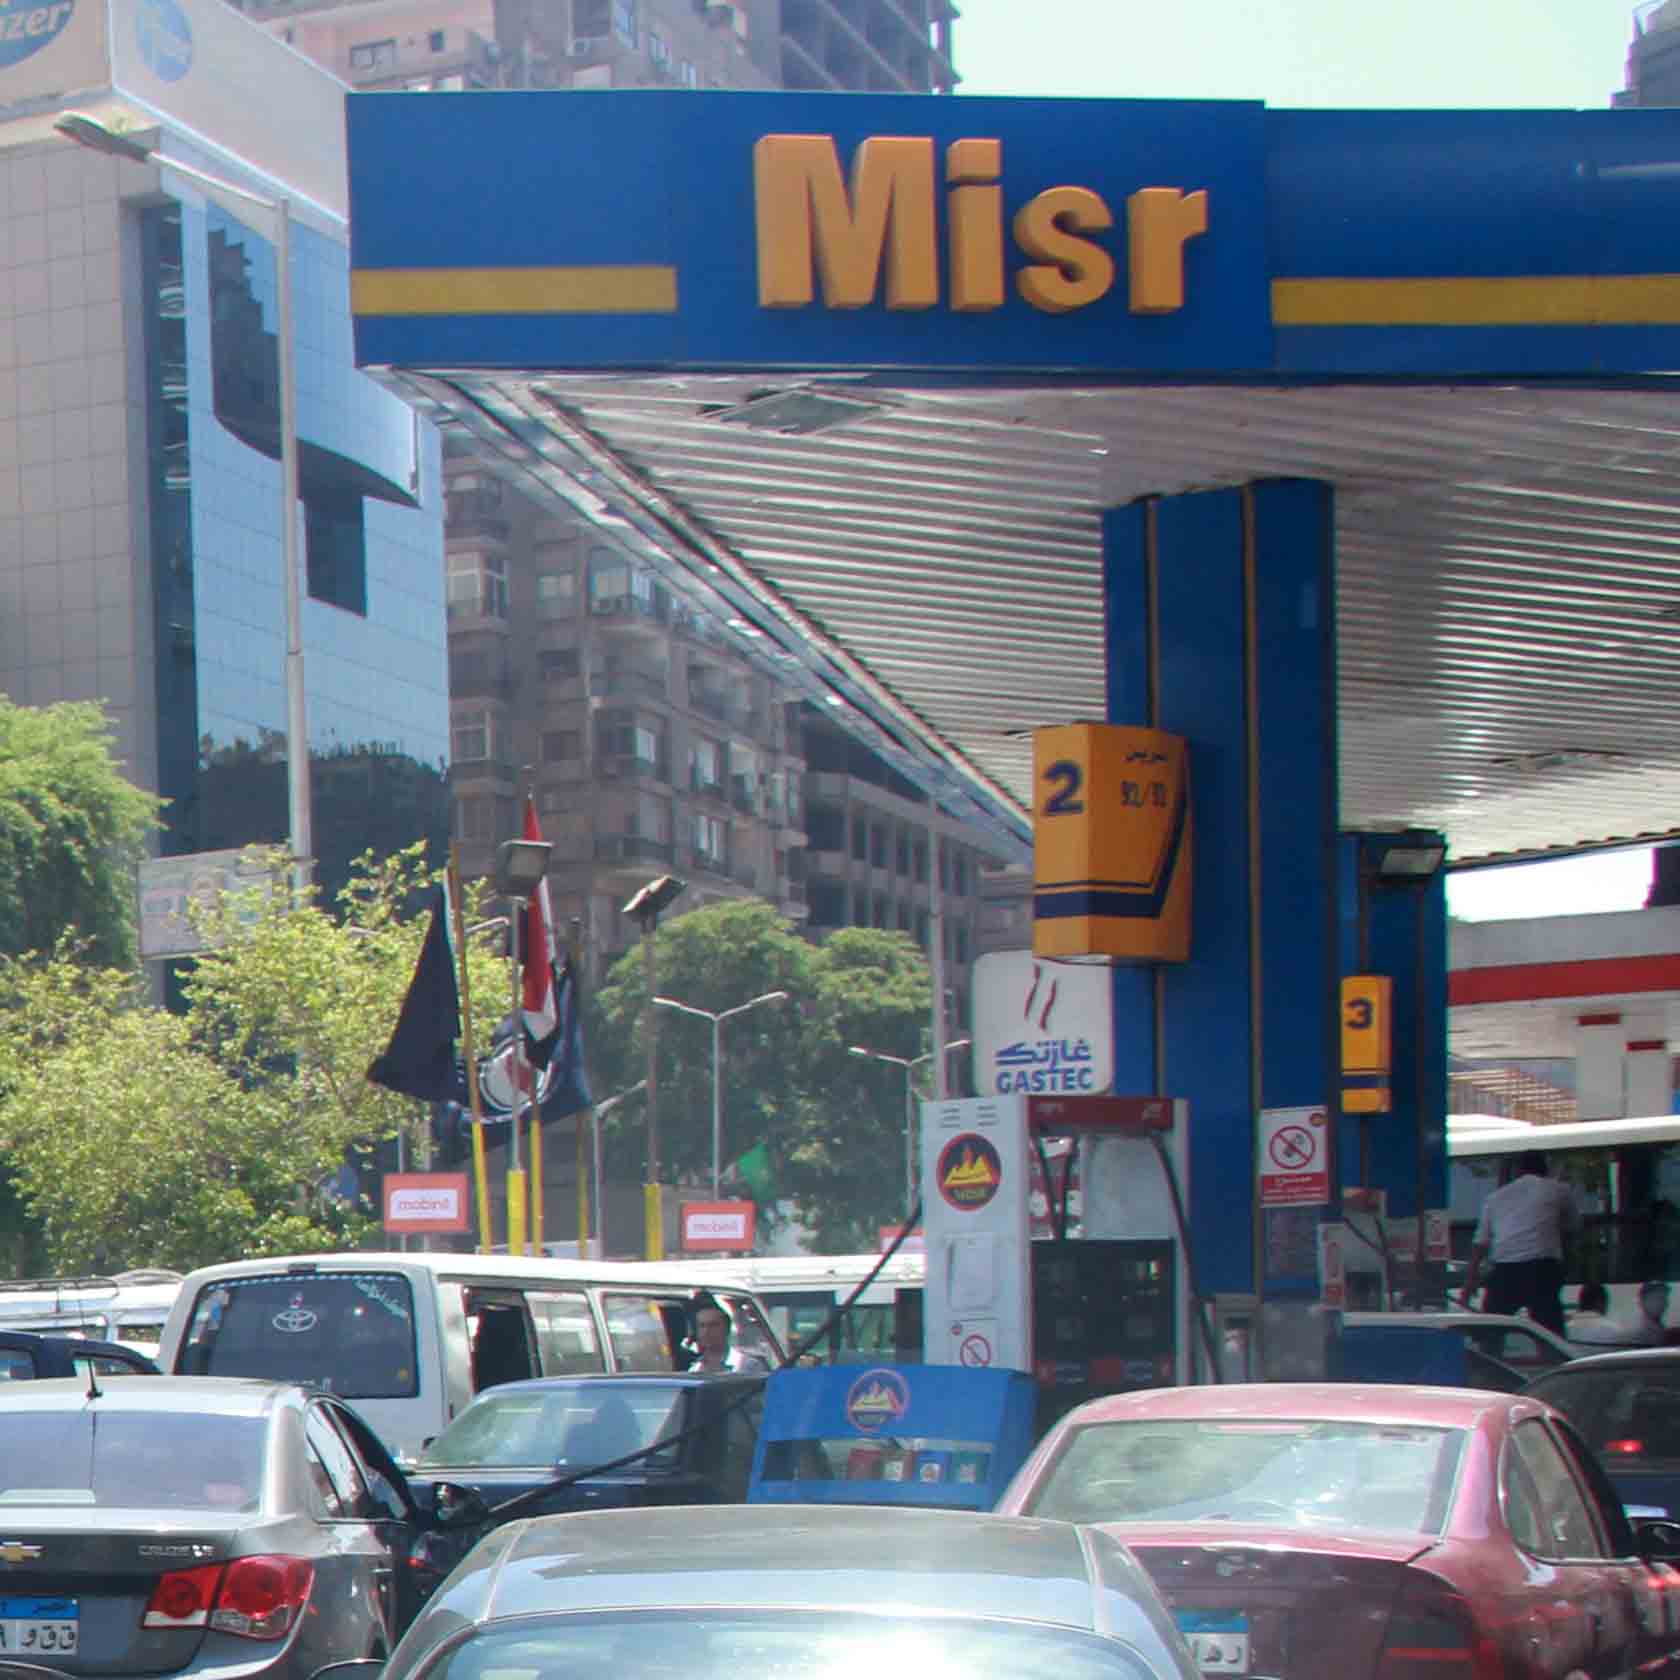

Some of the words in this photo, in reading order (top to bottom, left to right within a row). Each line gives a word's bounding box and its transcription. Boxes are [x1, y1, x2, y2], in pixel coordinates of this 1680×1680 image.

[753, 134, 1208, 314] Misr
[1044, 760, 1084, 814] 2
[1344, 997, 1374, 1030] 3
[996, 1068, 1093, 1094] GASTEC
